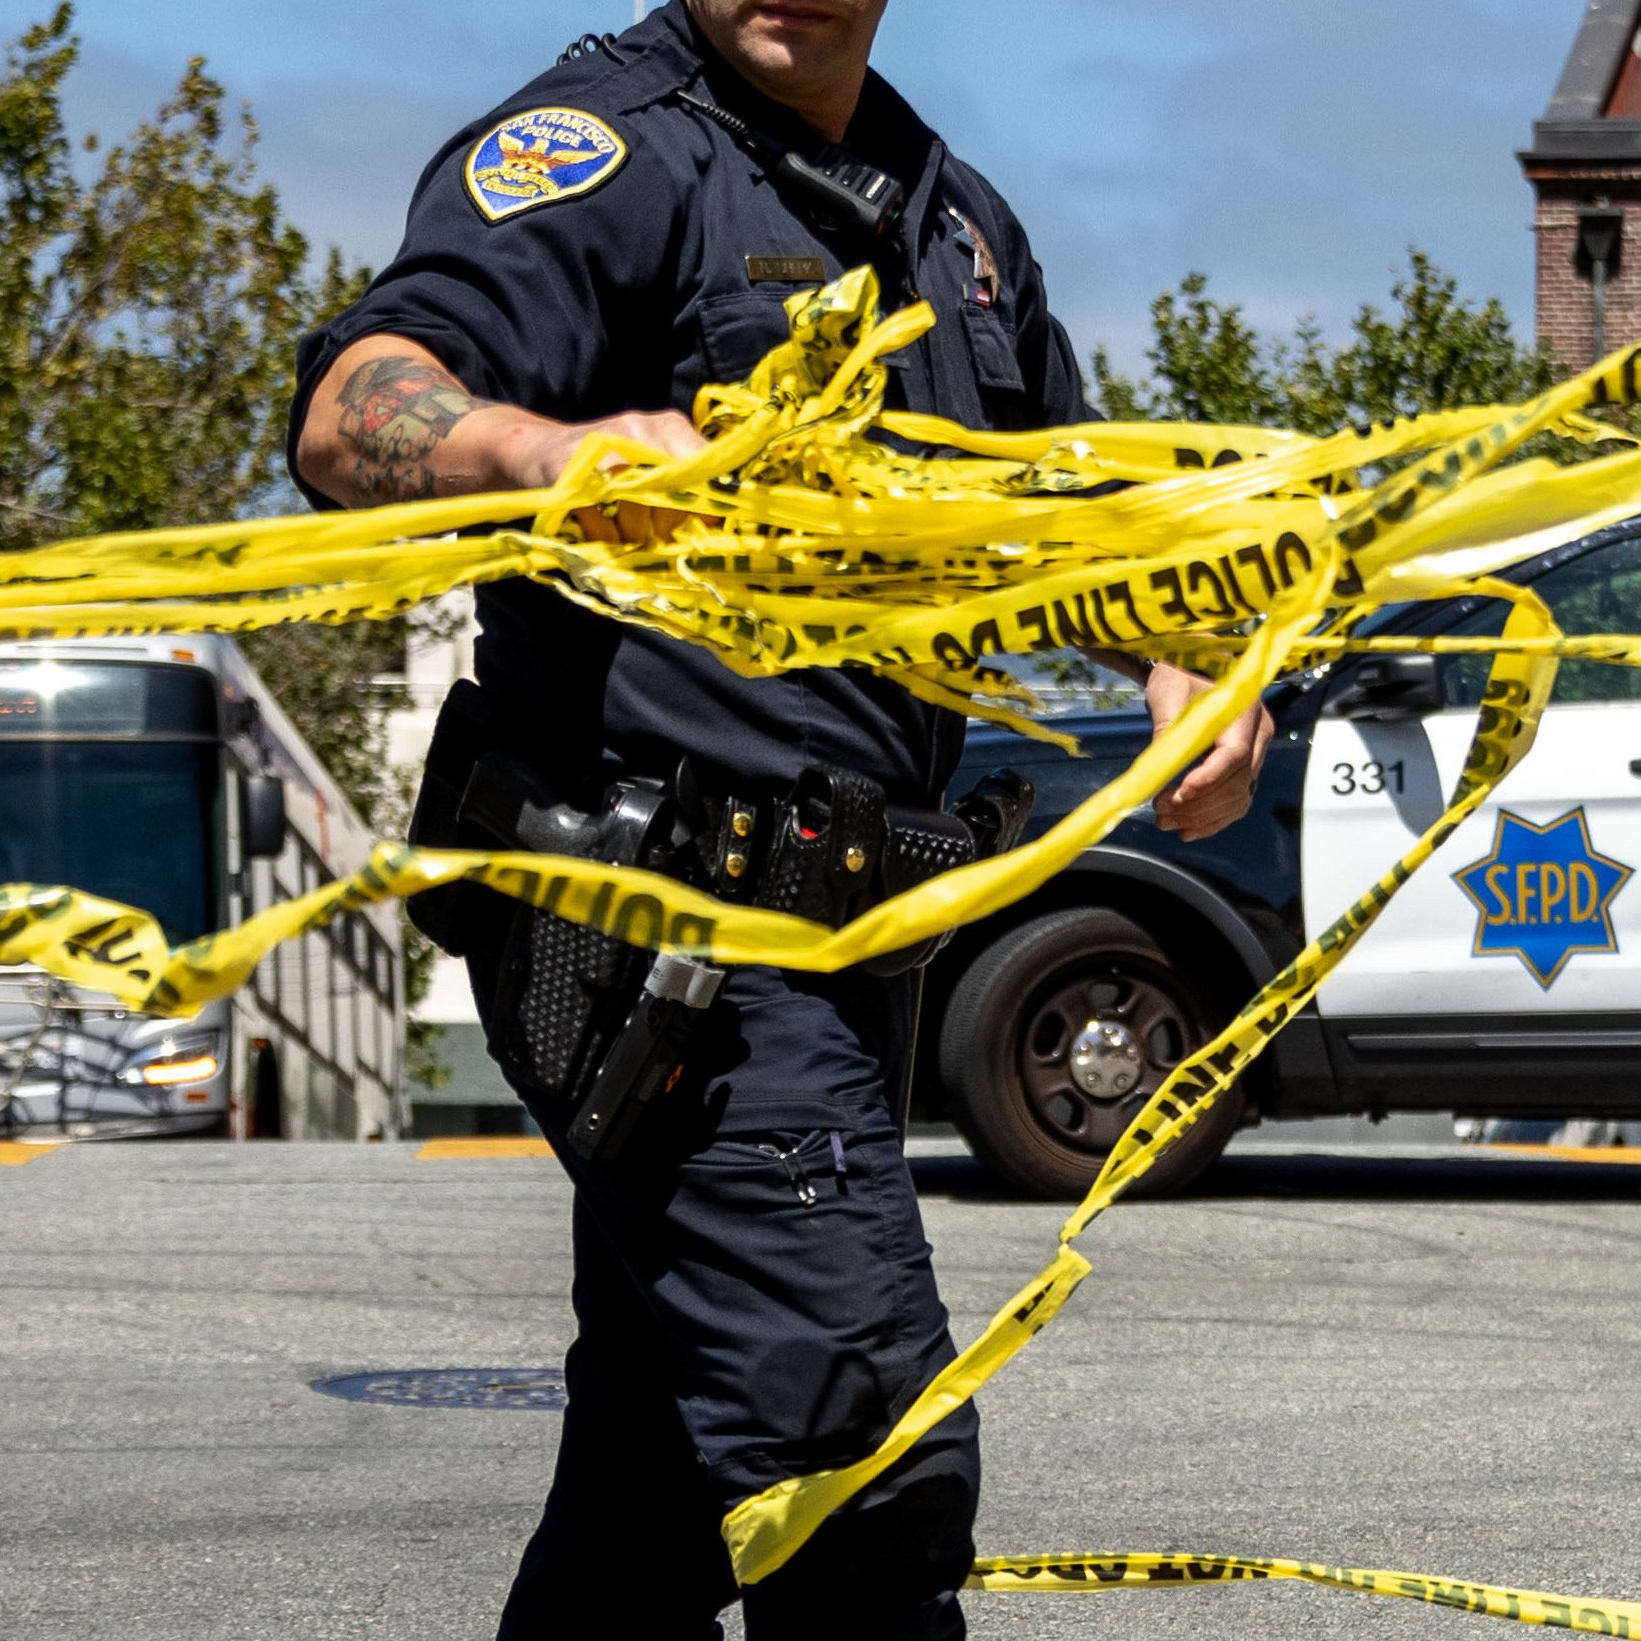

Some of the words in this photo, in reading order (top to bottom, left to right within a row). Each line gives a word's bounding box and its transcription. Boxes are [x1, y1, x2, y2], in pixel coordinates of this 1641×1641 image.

[521, 125, 581, 148] POLICE
[539, 113, 616, 153] FRANCISCO
[1017, 579, 1152, 656] LINE
[1331, 761, 1405, 795] 331
[1484, 861, 1600, 926] S.F.P.D.
